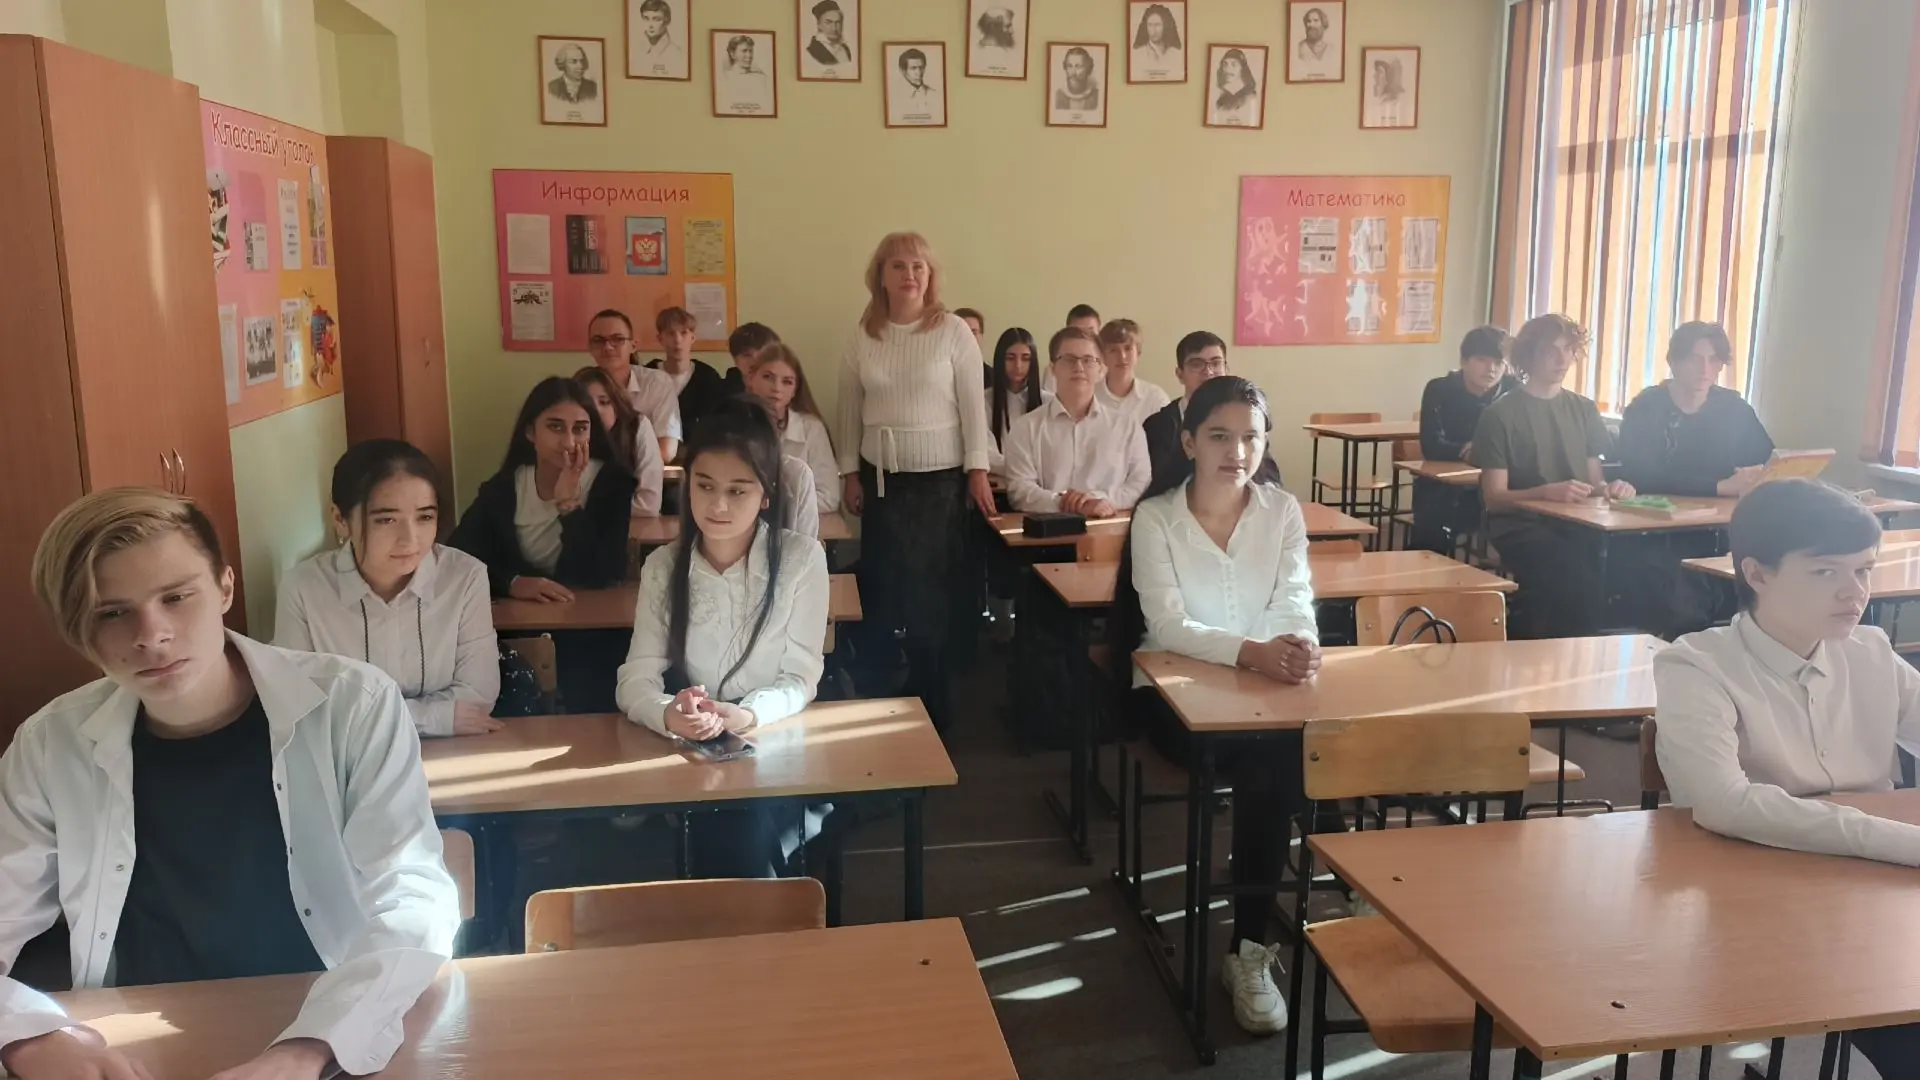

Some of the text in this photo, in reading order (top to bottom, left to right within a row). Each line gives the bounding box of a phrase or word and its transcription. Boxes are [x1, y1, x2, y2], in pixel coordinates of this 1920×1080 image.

[211, 110, 279, 156] Классный
[541, 181, 690, 207] Информация
[1287, 189, 1407, 207] Математика
